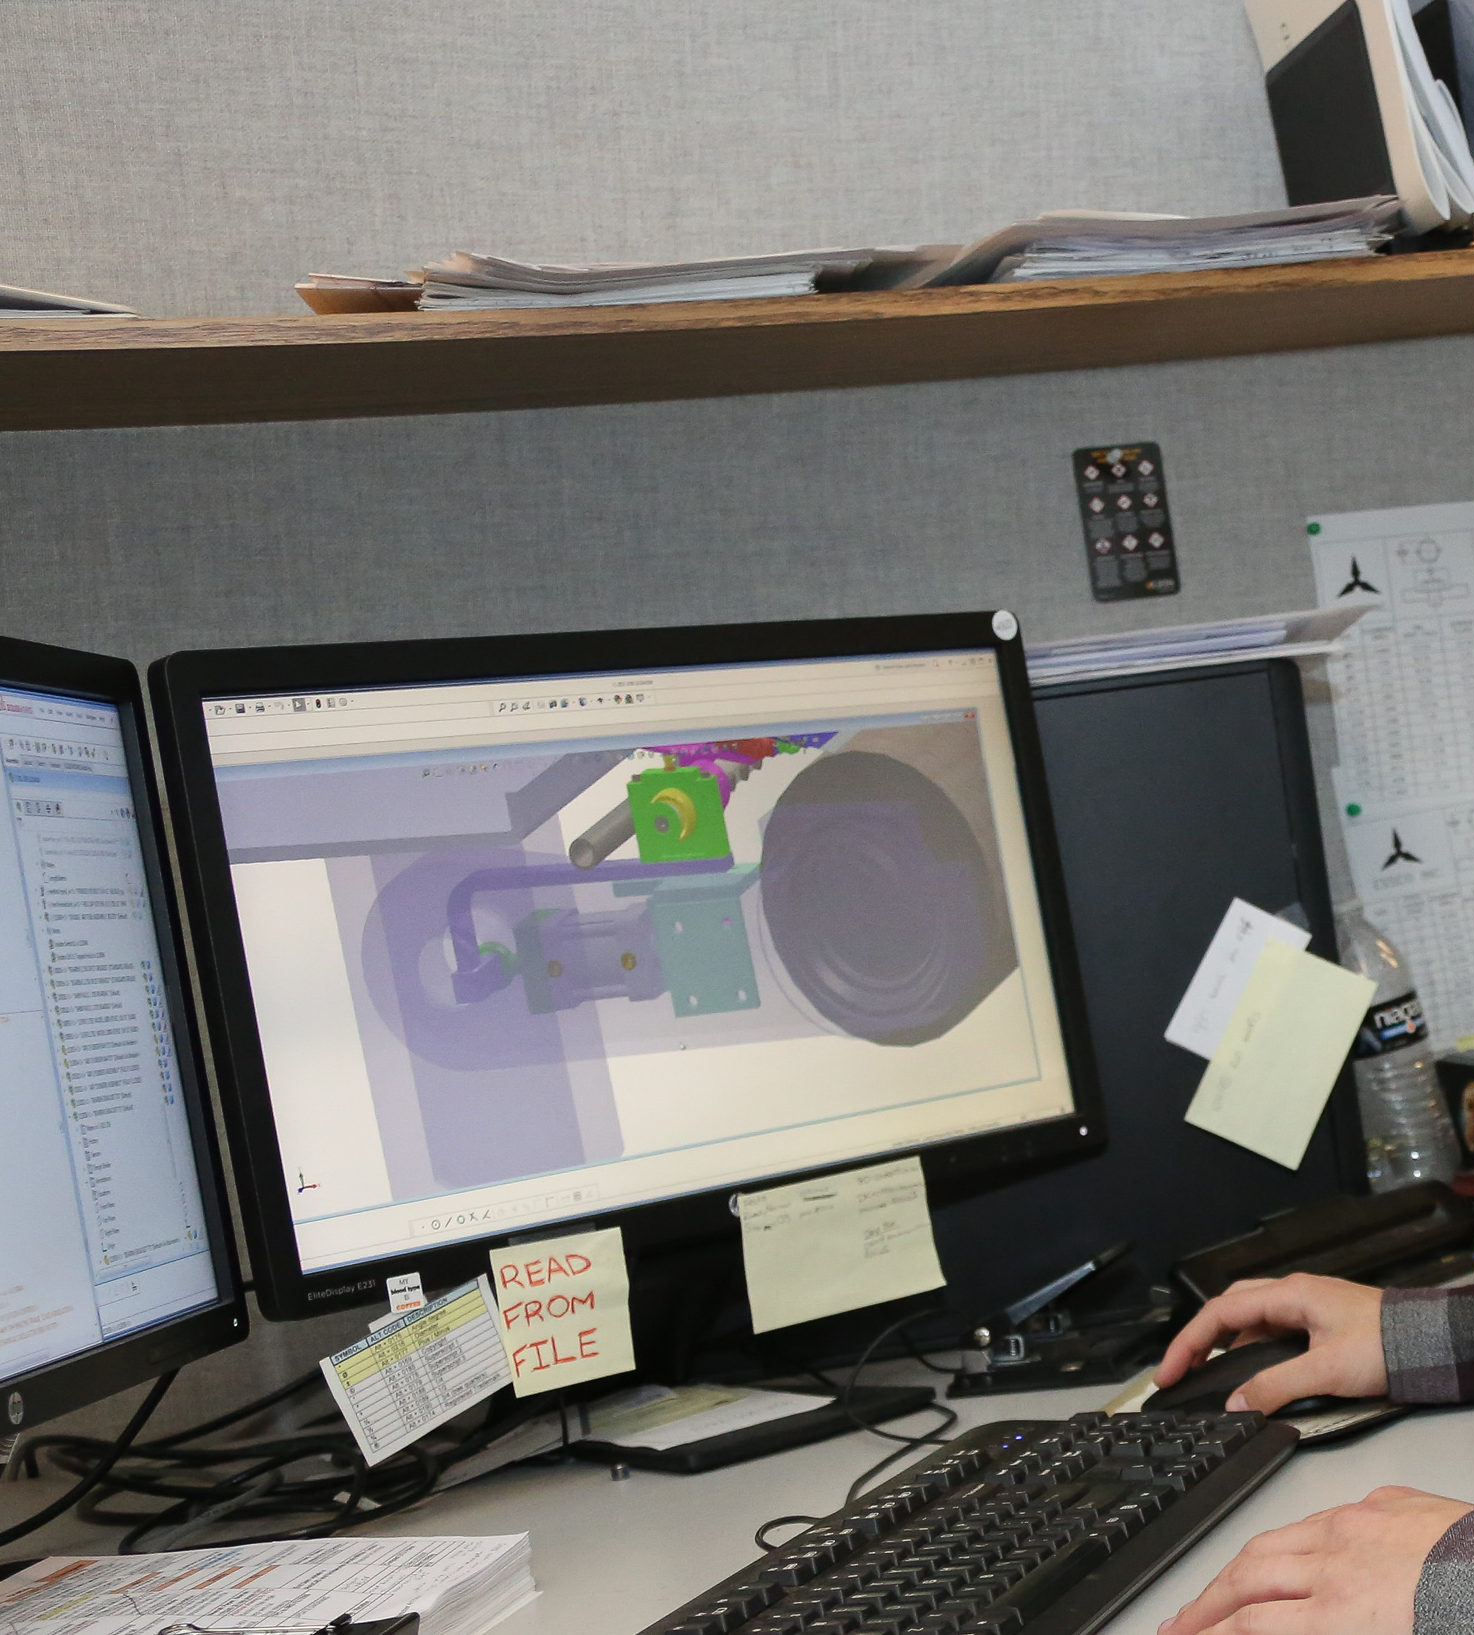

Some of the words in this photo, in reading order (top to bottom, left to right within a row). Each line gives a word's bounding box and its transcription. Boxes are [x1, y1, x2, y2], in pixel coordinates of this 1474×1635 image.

[500, 1254, 592, 1289] READ
[308, 1285, 355, 1301] EliteDisplay
[503, 1290, 595, 1330] FROM
[369, 1331, 383, 1342] ALT
[382, 1322, 401, 1336] CODE
[334, 1343, 361, 1361] SYMBOL
[512, 1327, 600, 1378] FILE
